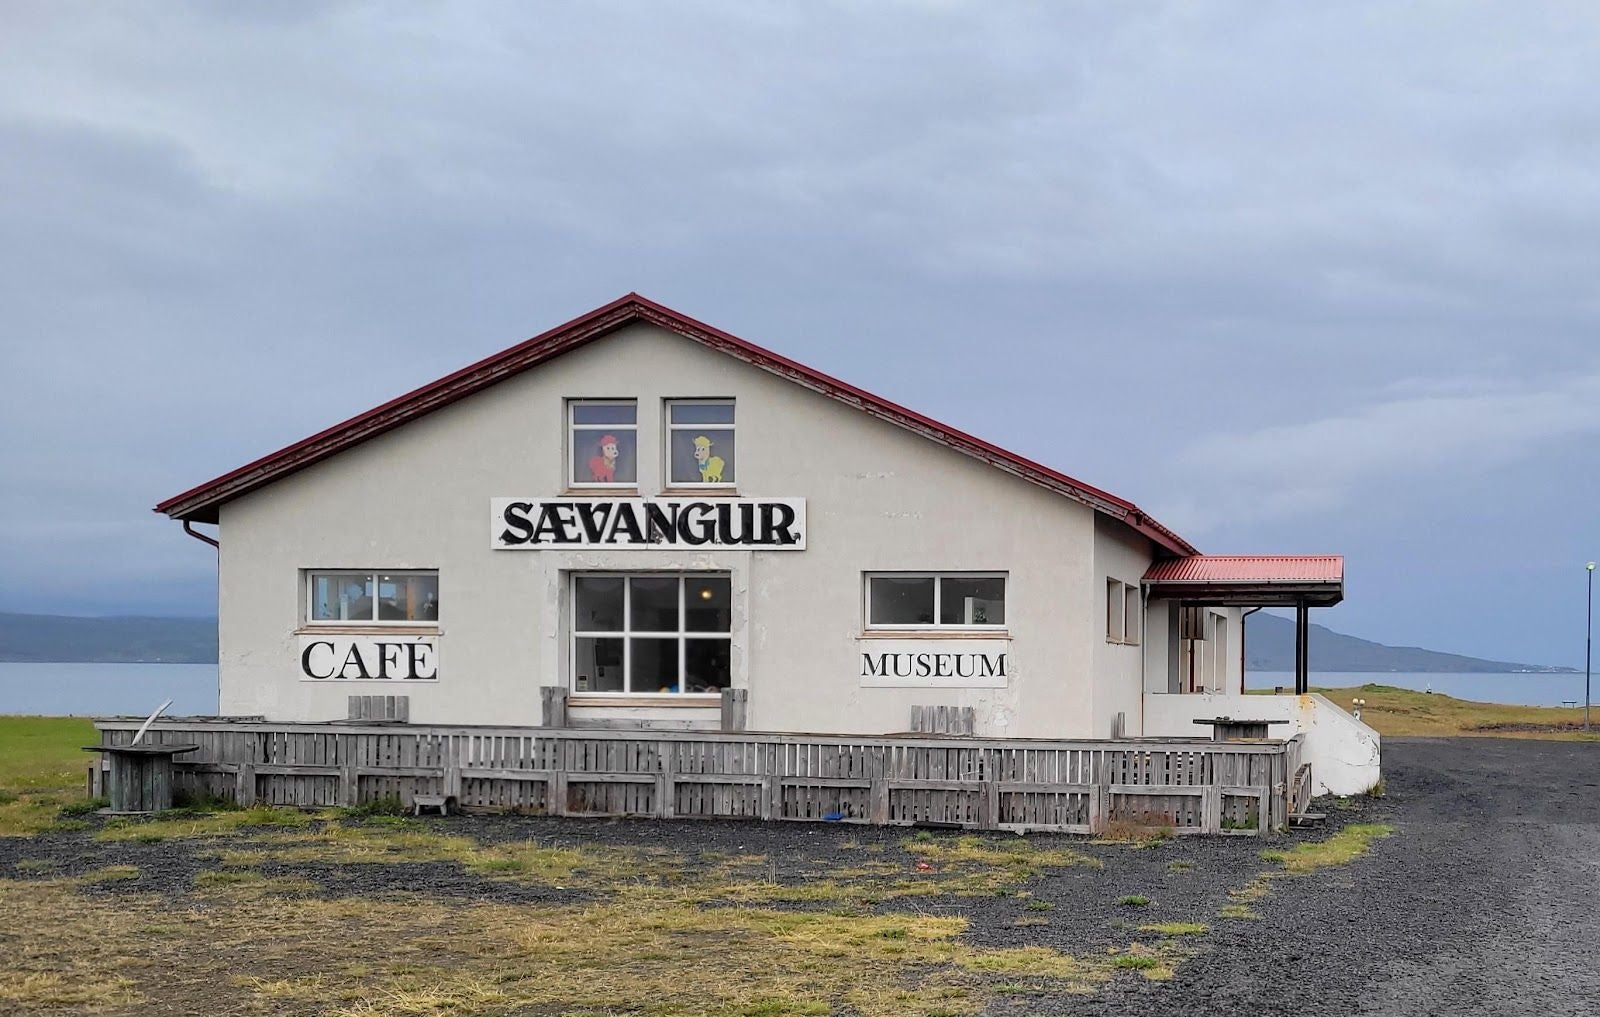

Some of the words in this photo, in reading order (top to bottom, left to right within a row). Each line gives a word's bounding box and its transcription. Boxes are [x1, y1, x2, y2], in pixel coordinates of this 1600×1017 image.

[500, 502, 801, 545] SÆVANGUR
[301, 636, 437, 680] CAFÉ
[861, 653, 1007, 678] MUSEUM
